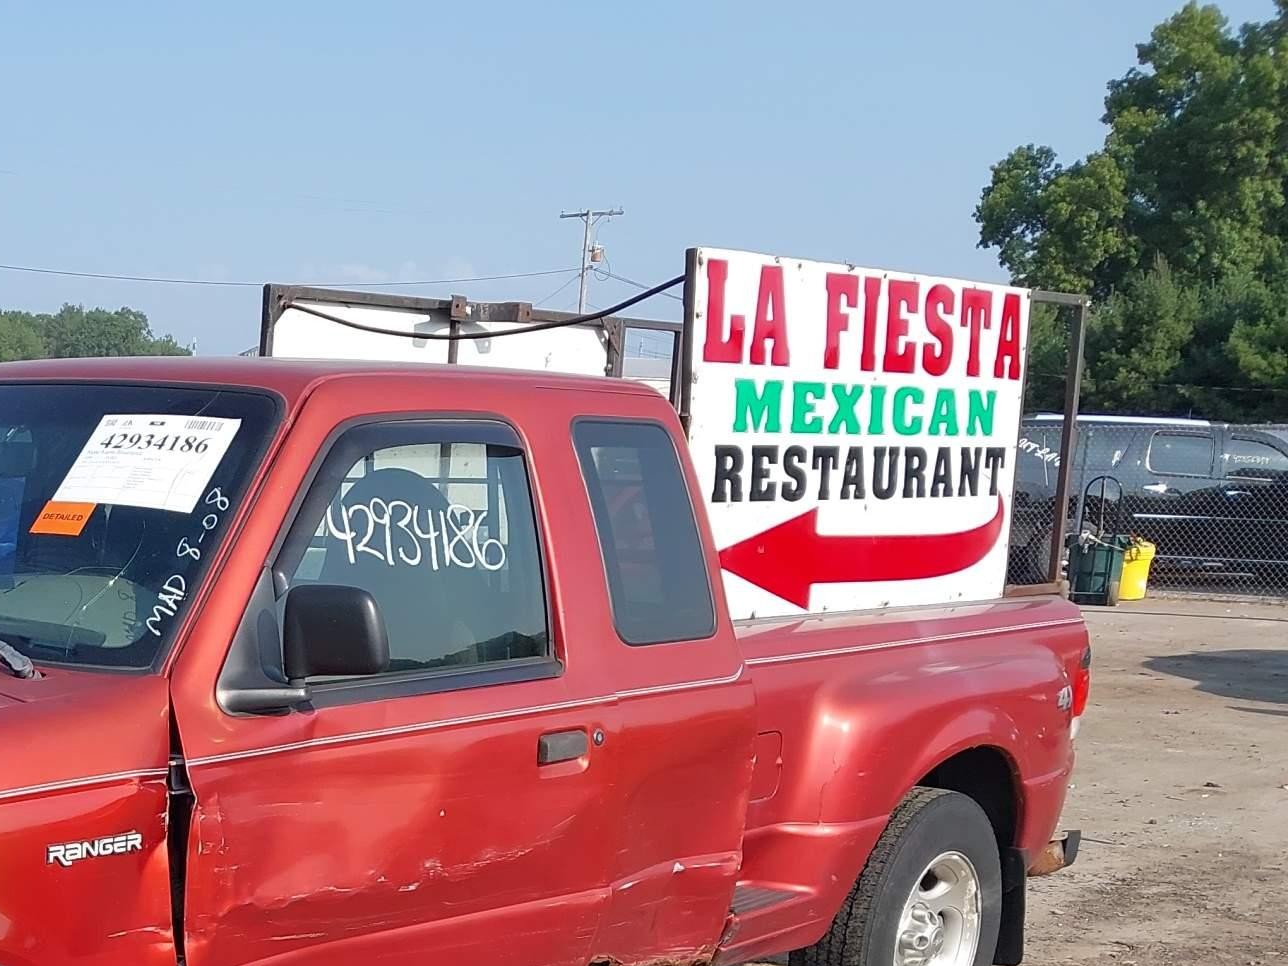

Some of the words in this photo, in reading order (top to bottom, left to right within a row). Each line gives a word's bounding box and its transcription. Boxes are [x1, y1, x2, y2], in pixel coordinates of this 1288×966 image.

[703, 259, 789, 367] LA
[823, 272, 1021, 381] FIESTA
[733, 378, 998, 437] MEXICAN
[100, 432, 212, 455] 42934186
[711, 445, 1005, 502] RESTAURANT
[42, 512, 84, 521] DETAILED
[326, 497, 507, 571] 42934186
[146, 574, 186, 637] MAD
[176, 487, 230, 561] 8-08
[46, 833, 143, 867] RANGER
